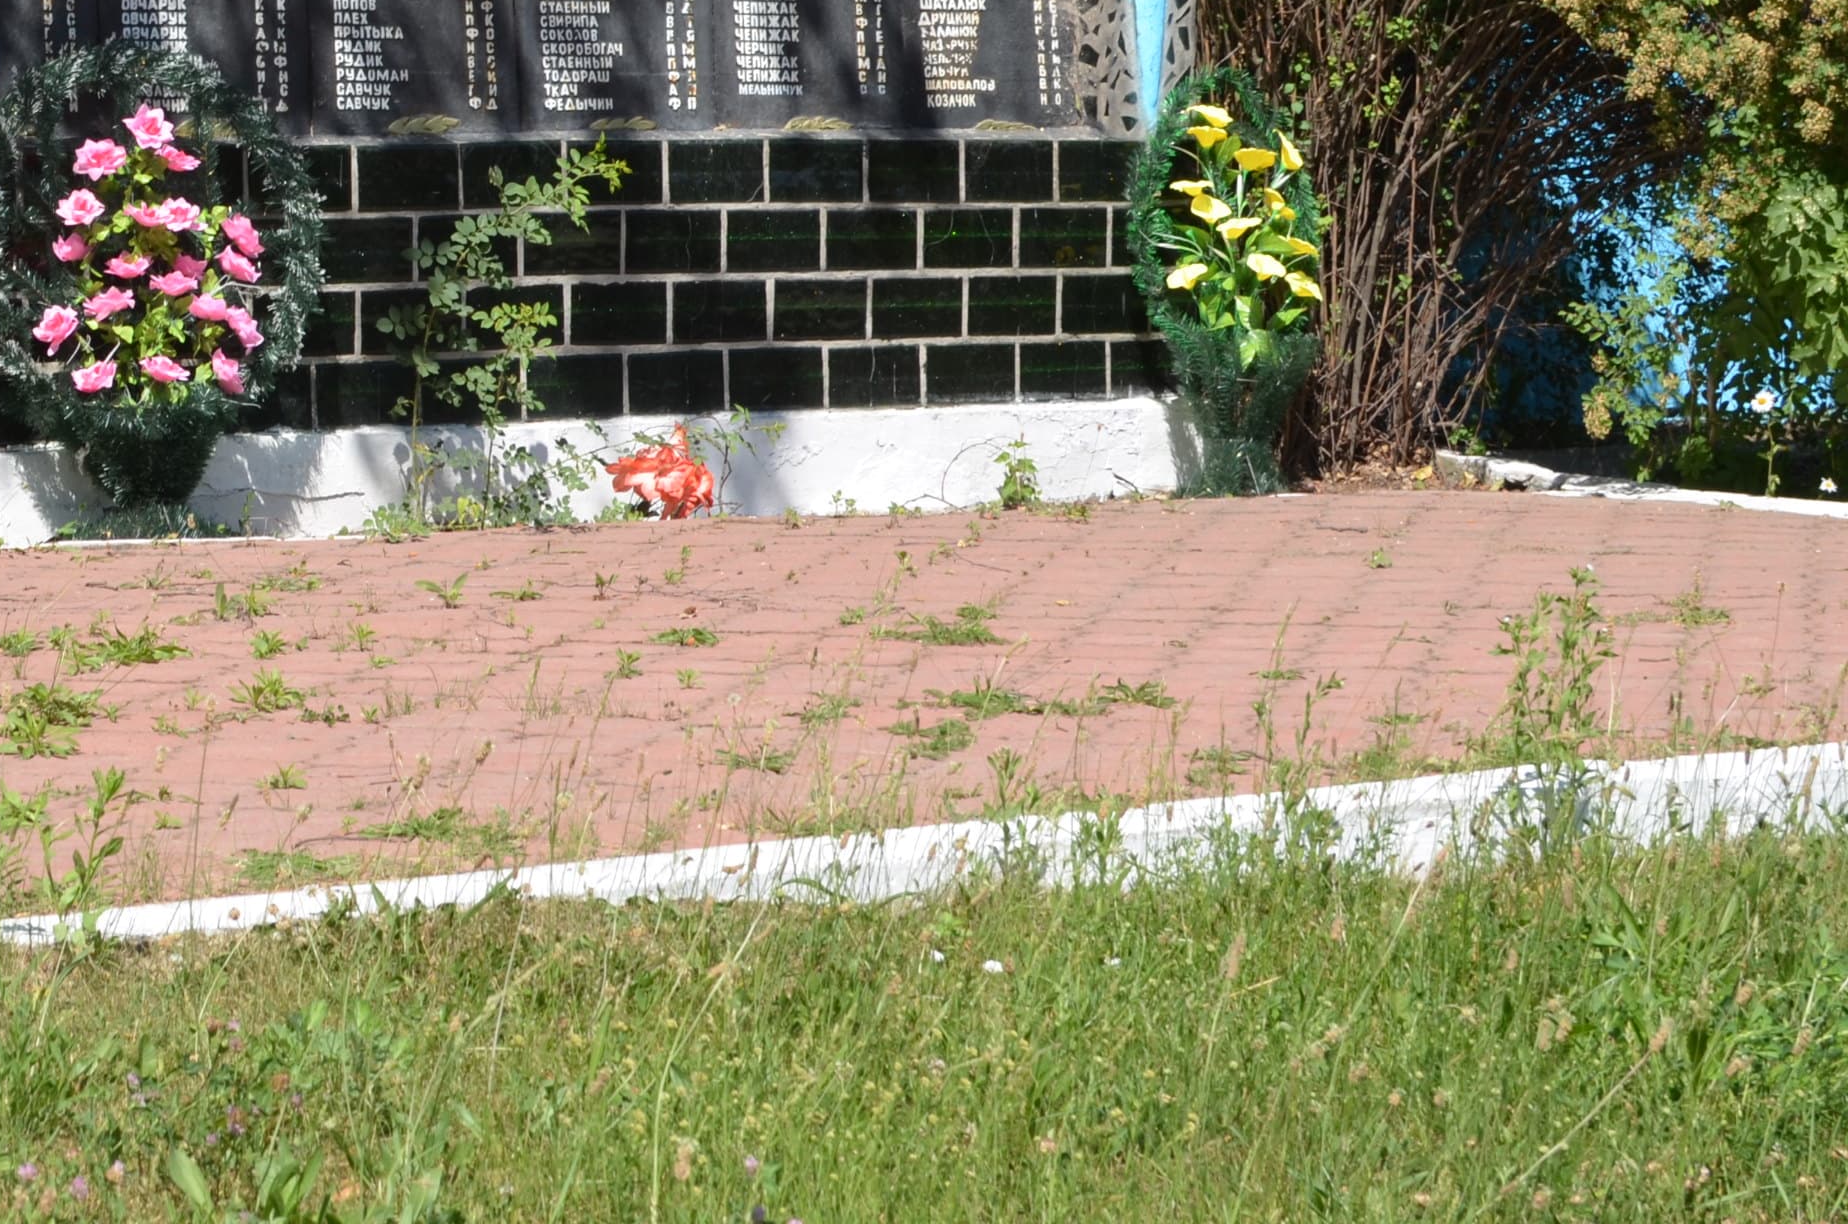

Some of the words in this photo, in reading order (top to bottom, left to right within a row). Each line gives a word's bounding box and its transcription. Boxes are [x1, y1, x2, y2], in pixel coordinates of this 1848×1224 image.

[734, 1, 797, 15] ЧЕПИЖАК
[122, 11, 186, 26] ОВЧАРУК
[334, 11, 368, 25] ПЛЕХ
[541, 15, 599, 29] СВИРИПА
[735, 15, 799, 29] ЧЕПИЖАК
[919, 11, 980, 26] ДРУЦКИЙ
[123, 26, 187, 41] ОВЧАРУК
[334, 25, 403, 40] ПРЫТЫКА
[541, 29, 598, 42] СОКОЛОВ
[736, 29, 799, 42] ЧЕПИЖАК
[335, 40, 382, 54] РУДИК
[542, 42, 623, 56] СКОРОБОГАЧ
[736, 42, 784, 56] ЧЕРЧИК
[336, 54, 383, 68] РУДИК
[737, 56, 798, 69] ЧЕПИЖАК
[337, 68, 408, 83] РУДОМАН
[544, 70, 610, 83] ТОДОРАШ
[738, 69, 799, 83] ЧЕПИЖАК
[337, 82, 391, 97] САВЧУК
[544, 83, 578, 97] ТКАЧ
[739, 83, 803, 97] МЕЛЬНИЧУК
[338, 97, 390, 111] САВЧУК
[545, 97, 613, 112] ФЕДЫЧИН
[927, 94, 976, 108] КОЗАЧОК
